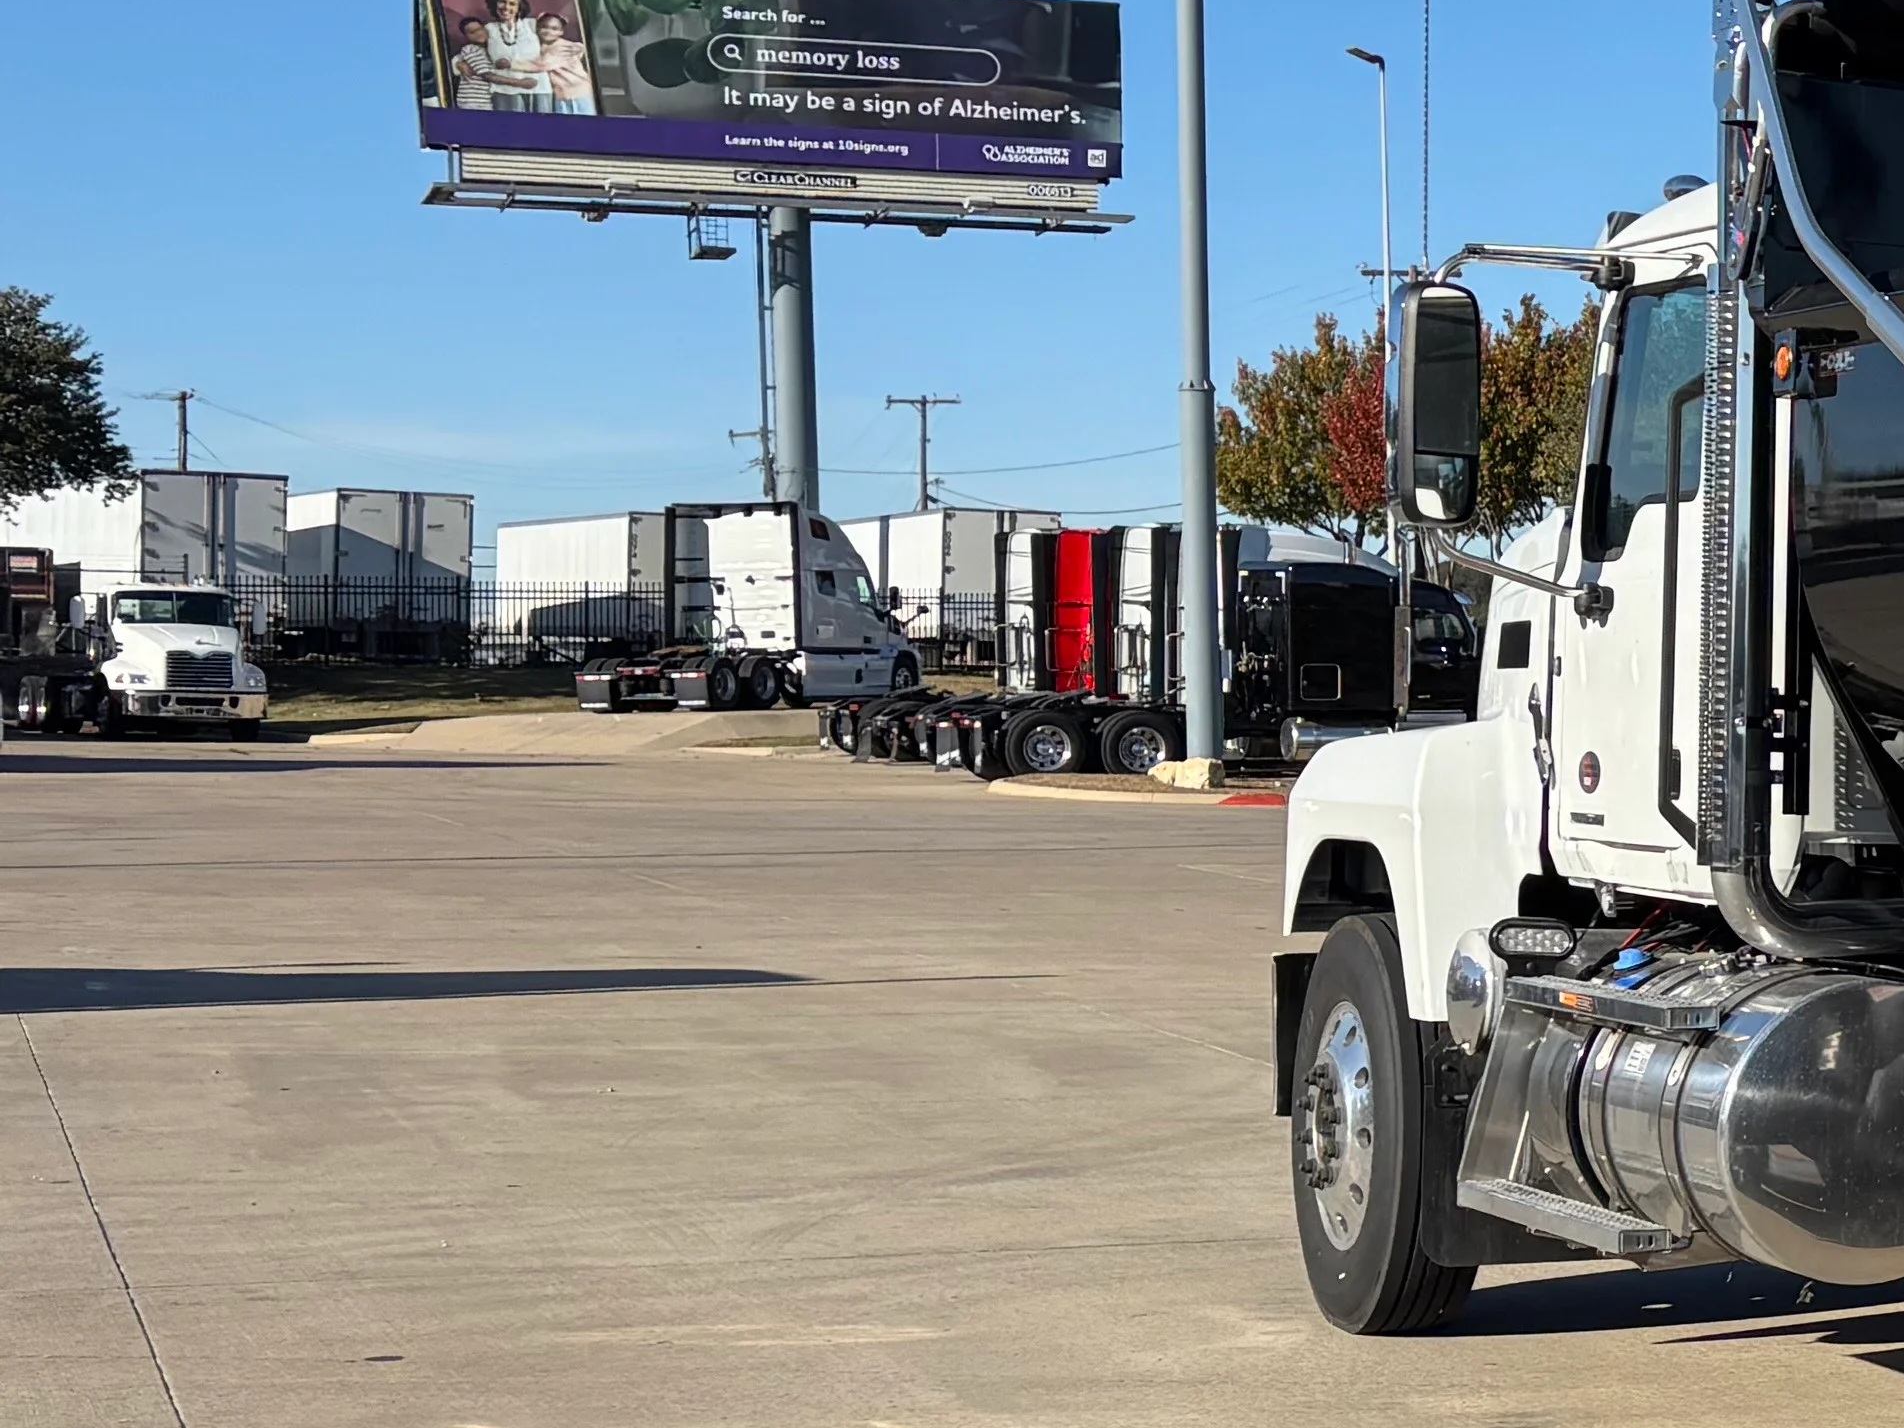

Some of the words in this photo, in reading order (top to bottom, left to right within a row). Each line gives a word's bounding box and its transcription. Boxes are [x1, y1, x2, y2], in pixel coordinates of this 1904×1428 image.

[722, 5, 777, 22] Search
[781, 9, 806, 23] for
[756, 49, 849, 70] memory
[857, 50, 900, 70] loss
[724, 86, 742, 106] It
[750, 92, 799, 113] may
[806, 90, 835, 110] be
[842, 97, 856, 112] a
[862, 93, 910, 119] sign
[918, 97, 944, 116] of
[949, 98, 1087, 125] Alzheimer's.
[725, 135, 761, 146] Learn
[764, 136, 785, 147] the
[788, 137, 819, 151] signs
[822, 140, 835, 150] at
[838, 140, 909, 156] 10signs.org
[1000, 154, 1070, 165] ASSOCIATION
